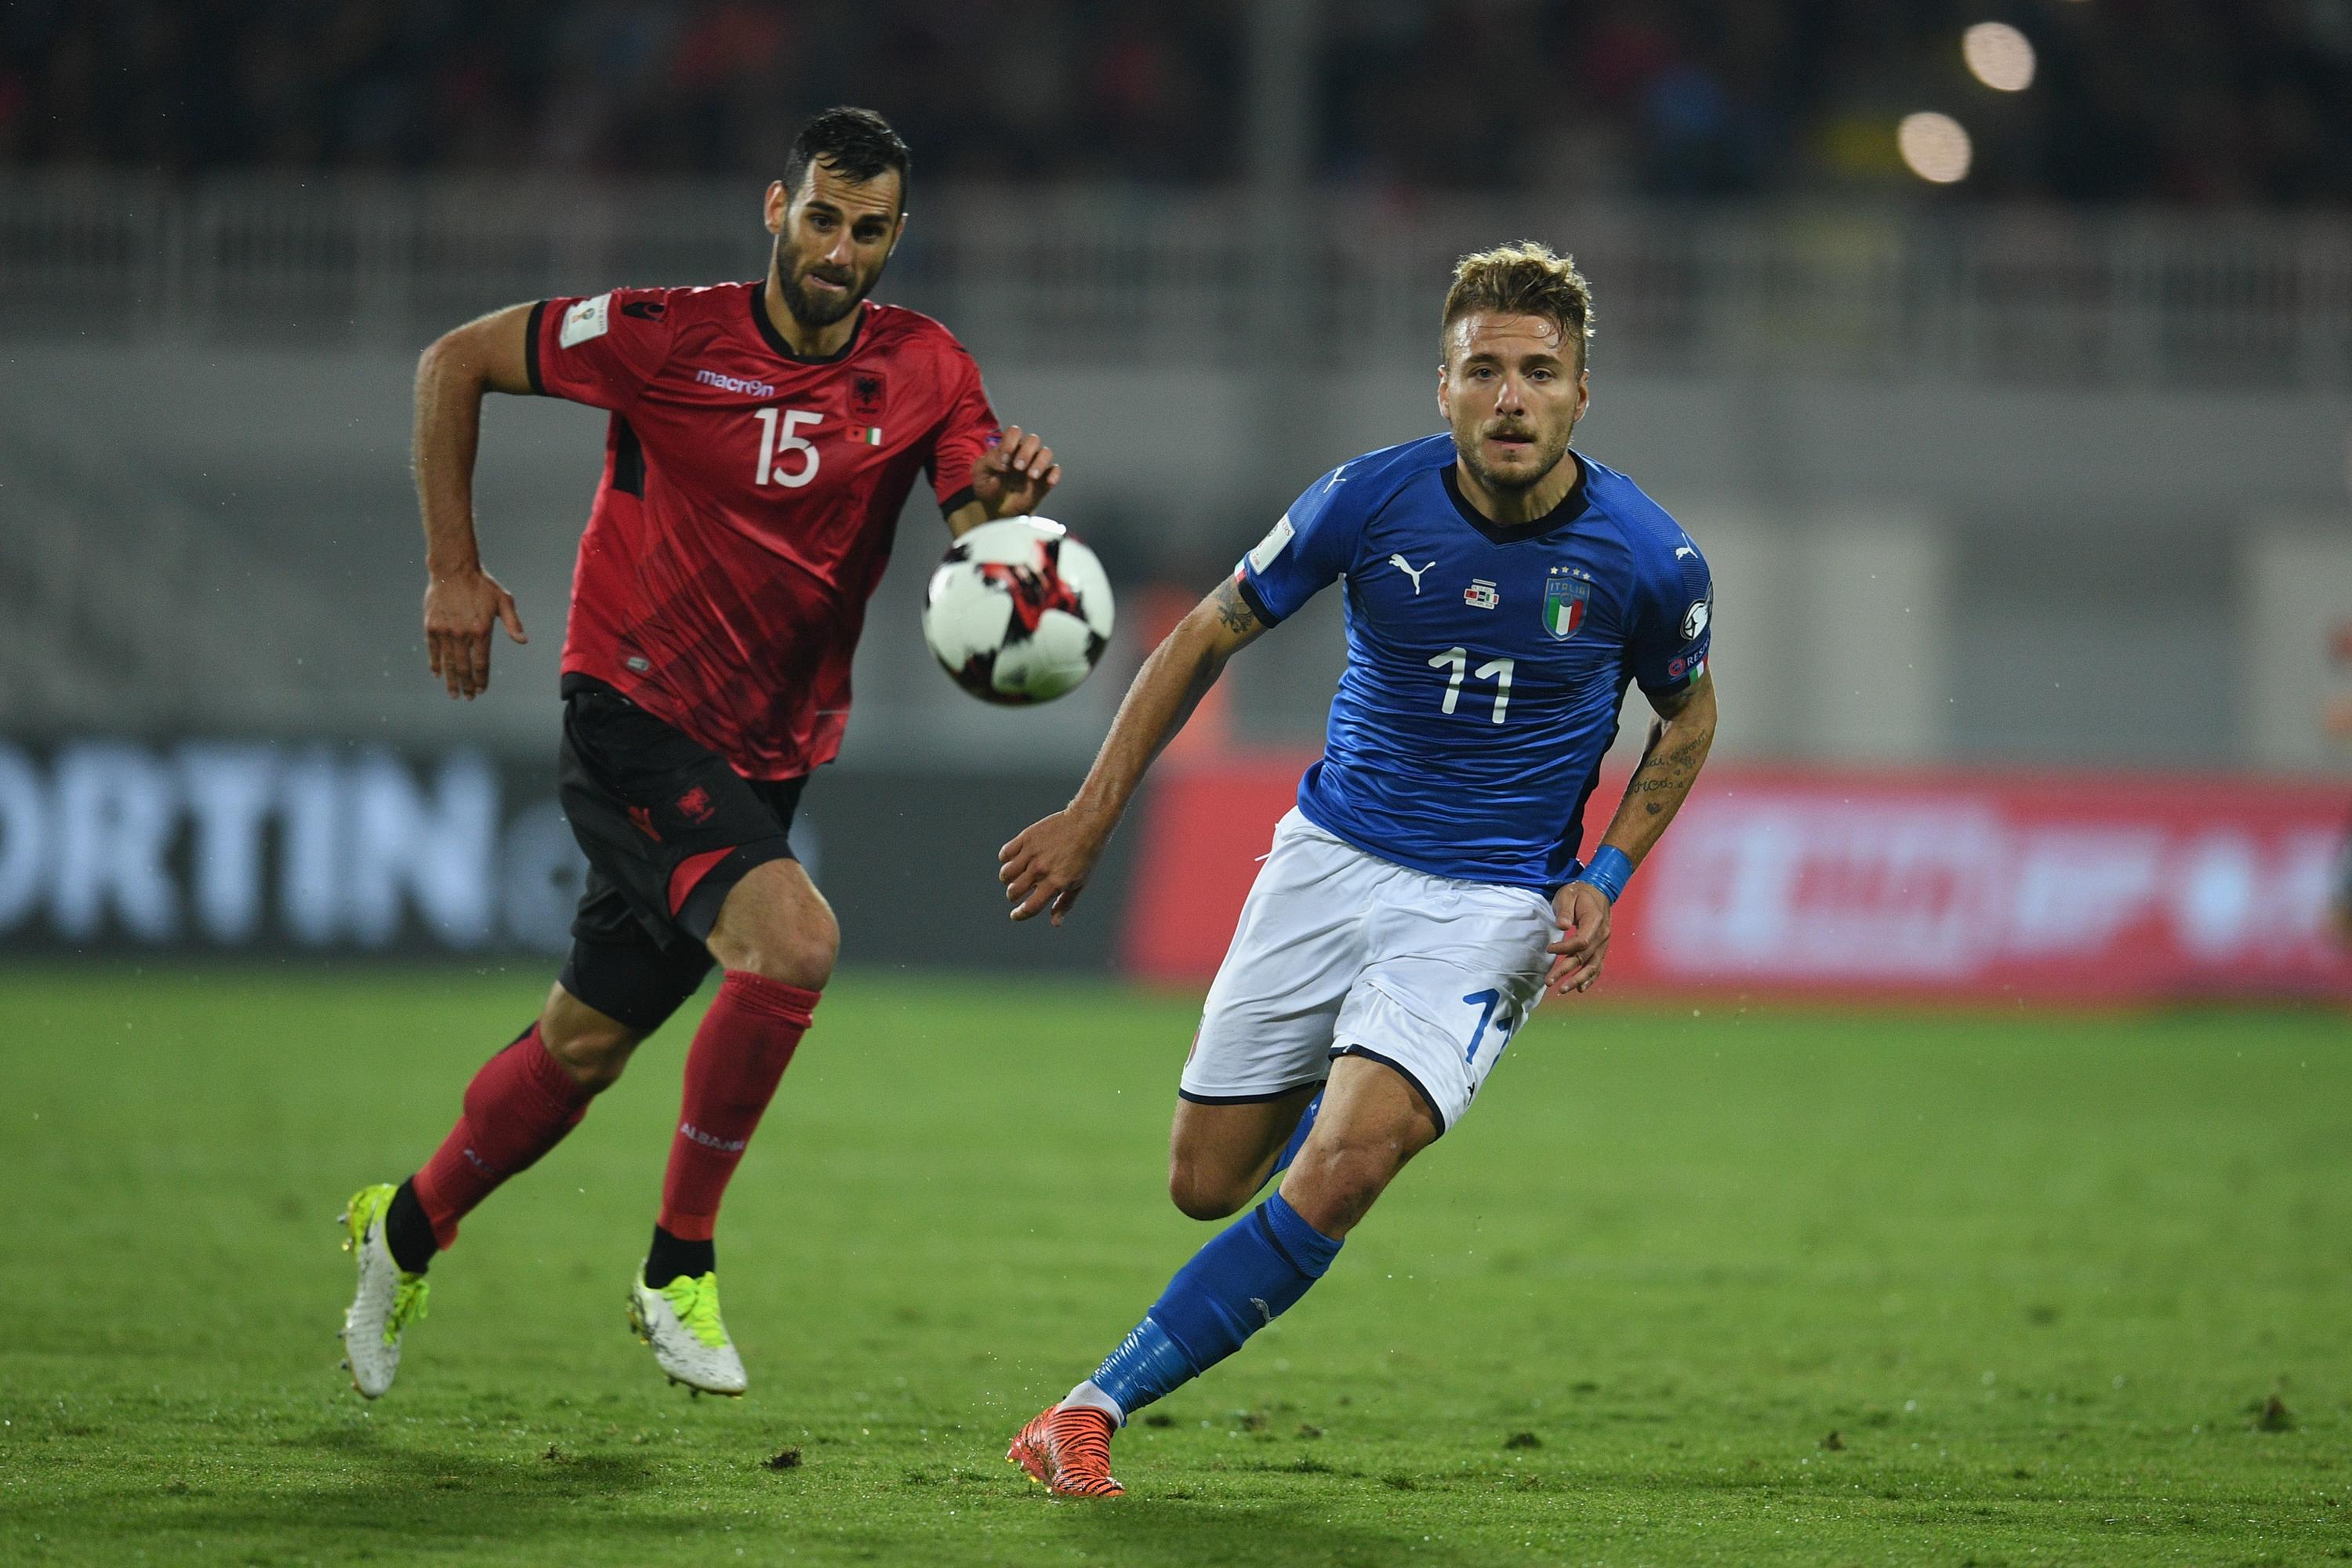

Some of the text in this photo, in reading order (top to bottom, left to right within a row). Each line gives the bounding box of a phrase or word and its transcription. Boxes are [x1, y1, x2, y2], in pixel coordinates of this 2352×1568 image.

[695, 370, 775, 397] macron
[753, 408, 825, 488] 15
[1428, 646, 1515, 724] 11
